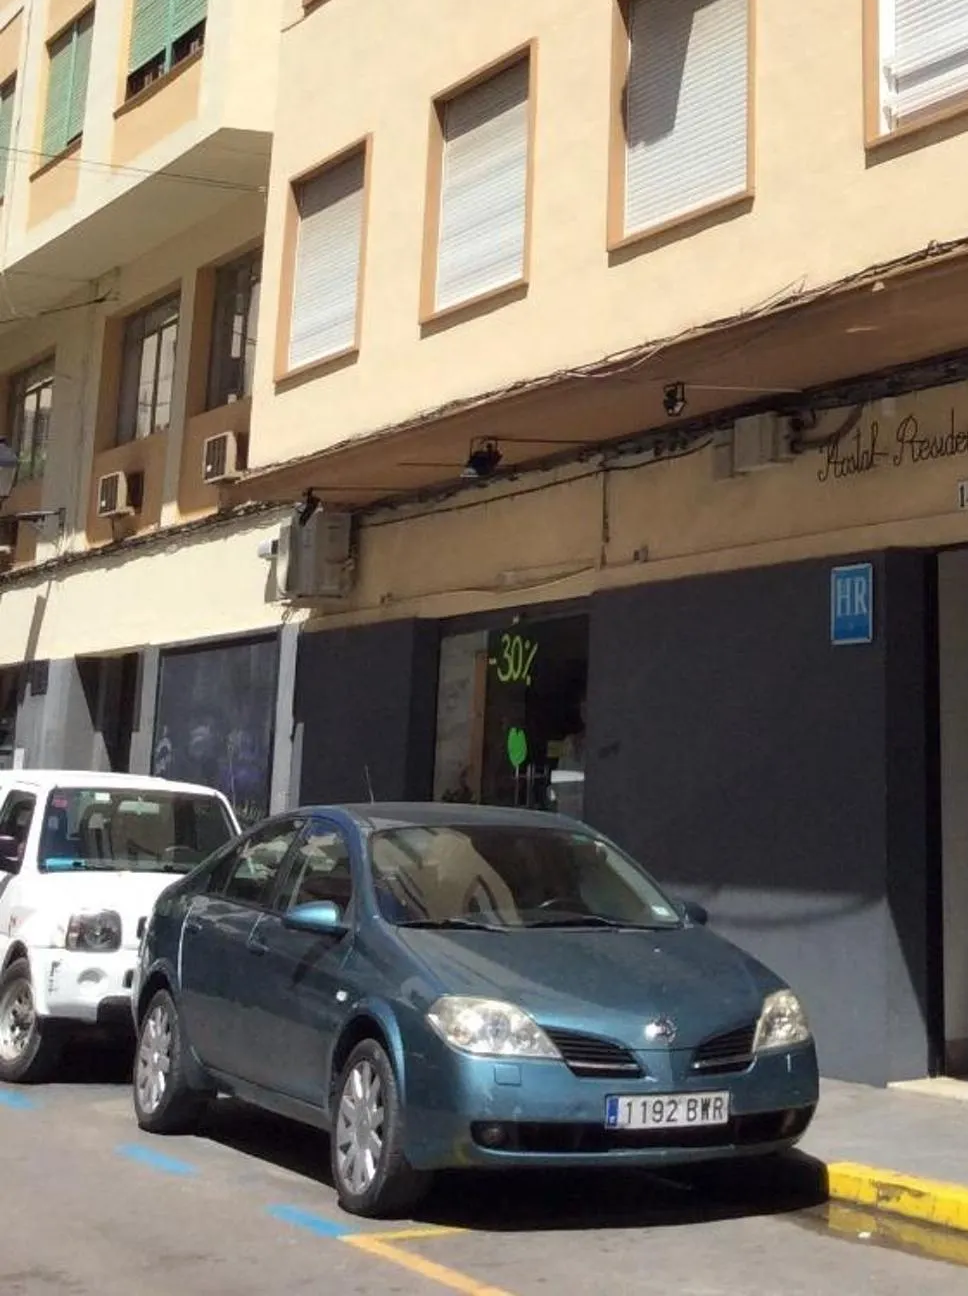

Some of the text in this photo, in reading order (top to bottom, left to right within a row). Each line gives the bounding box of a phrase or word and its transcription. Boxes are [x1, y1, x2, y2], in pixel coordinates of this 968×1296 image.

[836, 576, 868, 616] HR
[626, 1096, 723, 1125] 1192 BWR
